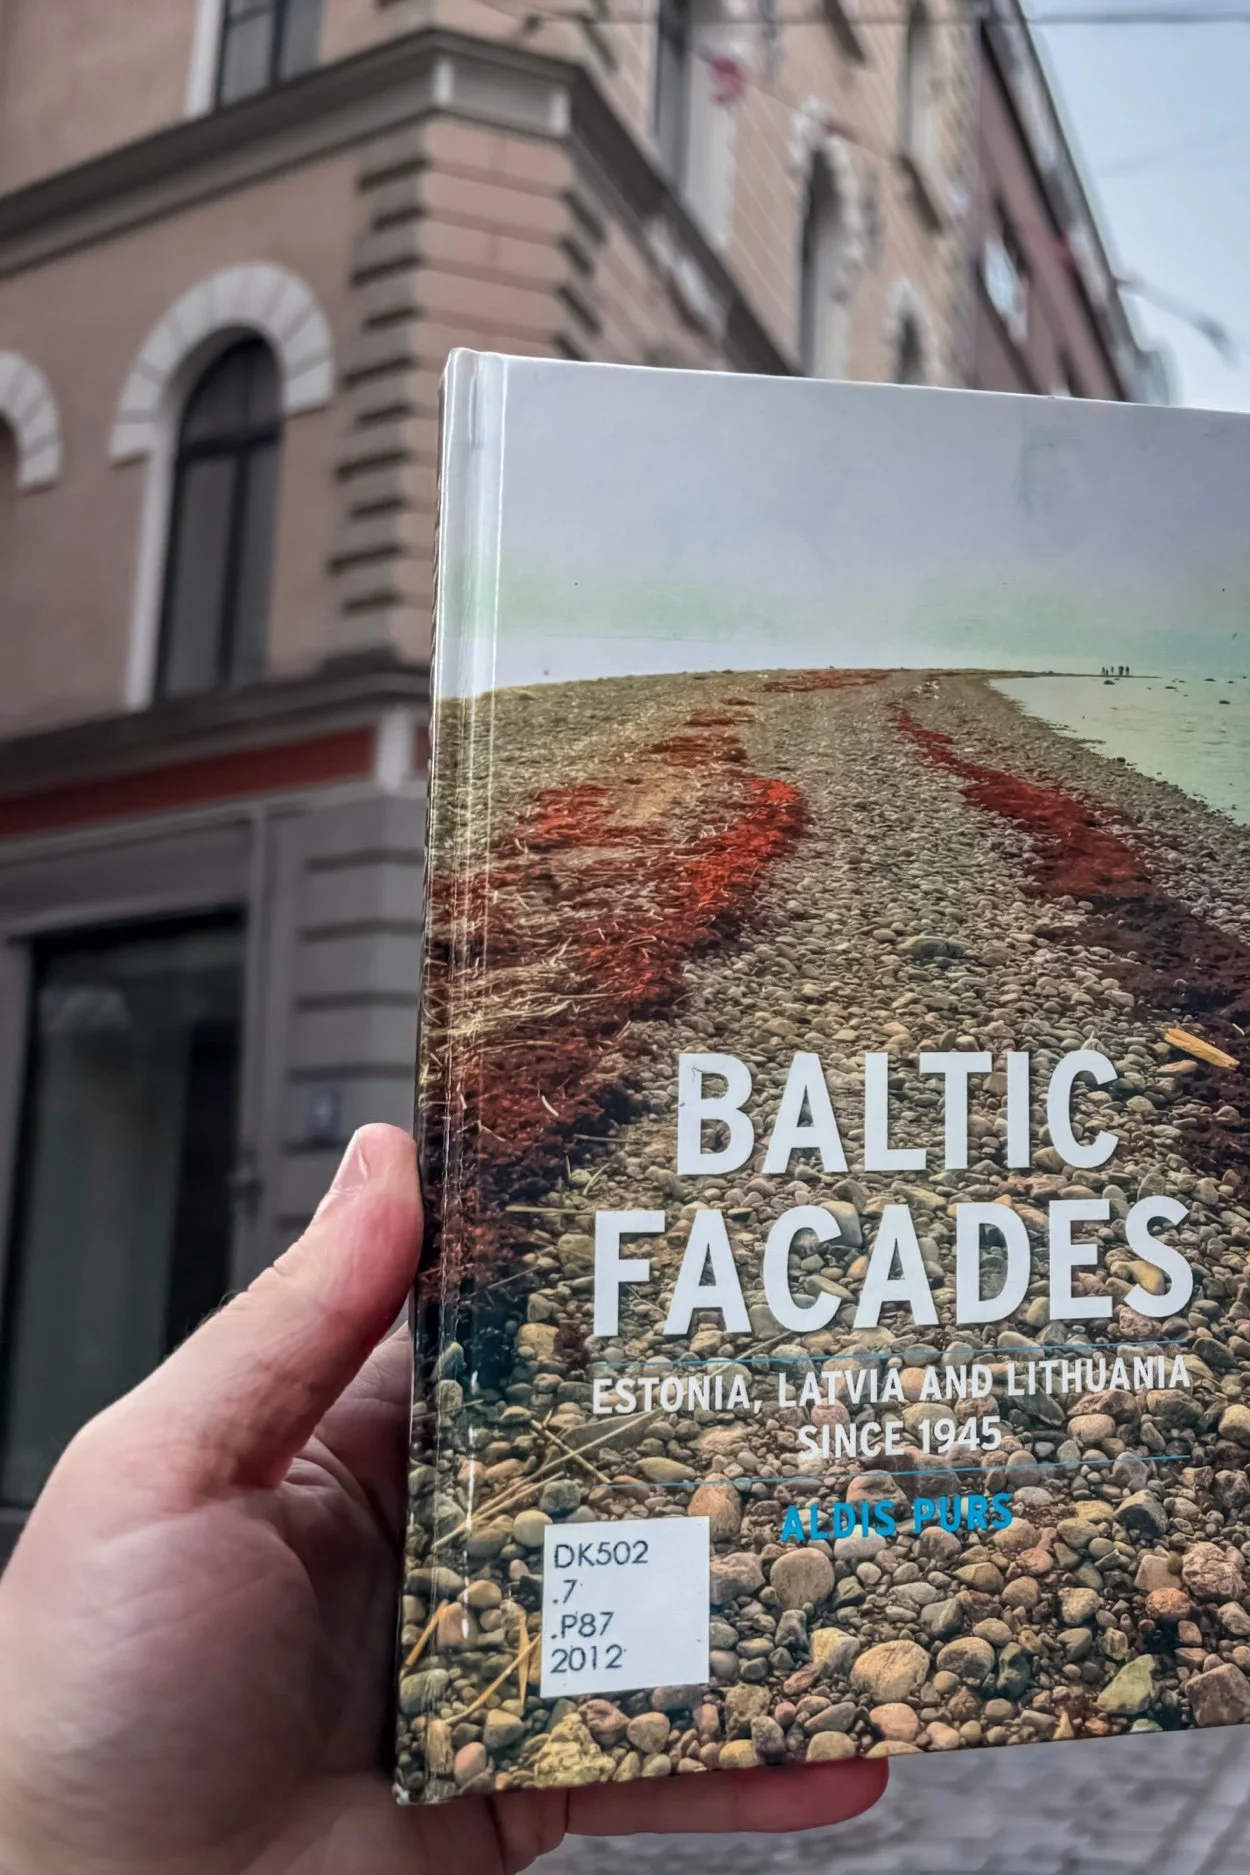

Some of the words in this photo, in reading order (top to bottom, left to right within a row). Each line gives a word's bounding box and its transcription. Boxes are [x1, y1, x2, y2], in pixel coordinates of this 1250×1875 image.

[677, 1050, 1119, 1175] BALTIC
[593, 1196, 1194, 1336] FACADES
[592, 1374, 761, 1414] ESTONIA,
[778, 1368, 904, 1408] LATVIA
[920, 1364, 993, 1400] AND
[1007, 1354, 1191, 1396] LITHUANIA
[799, 1420, 904, 1460] SINCE
[918, 1415, 1002, 1454] 1945
[780, 1500, 897, 1542] ALDIS
[912, 1492, 1014, 1535] PURS
[554, 1540, 649, 1569] DK502
[552, 1579, 577, 1604] .7
[551, 1611, 614, 1639] .P87
[550, 1643, 623, 1673] 2012
